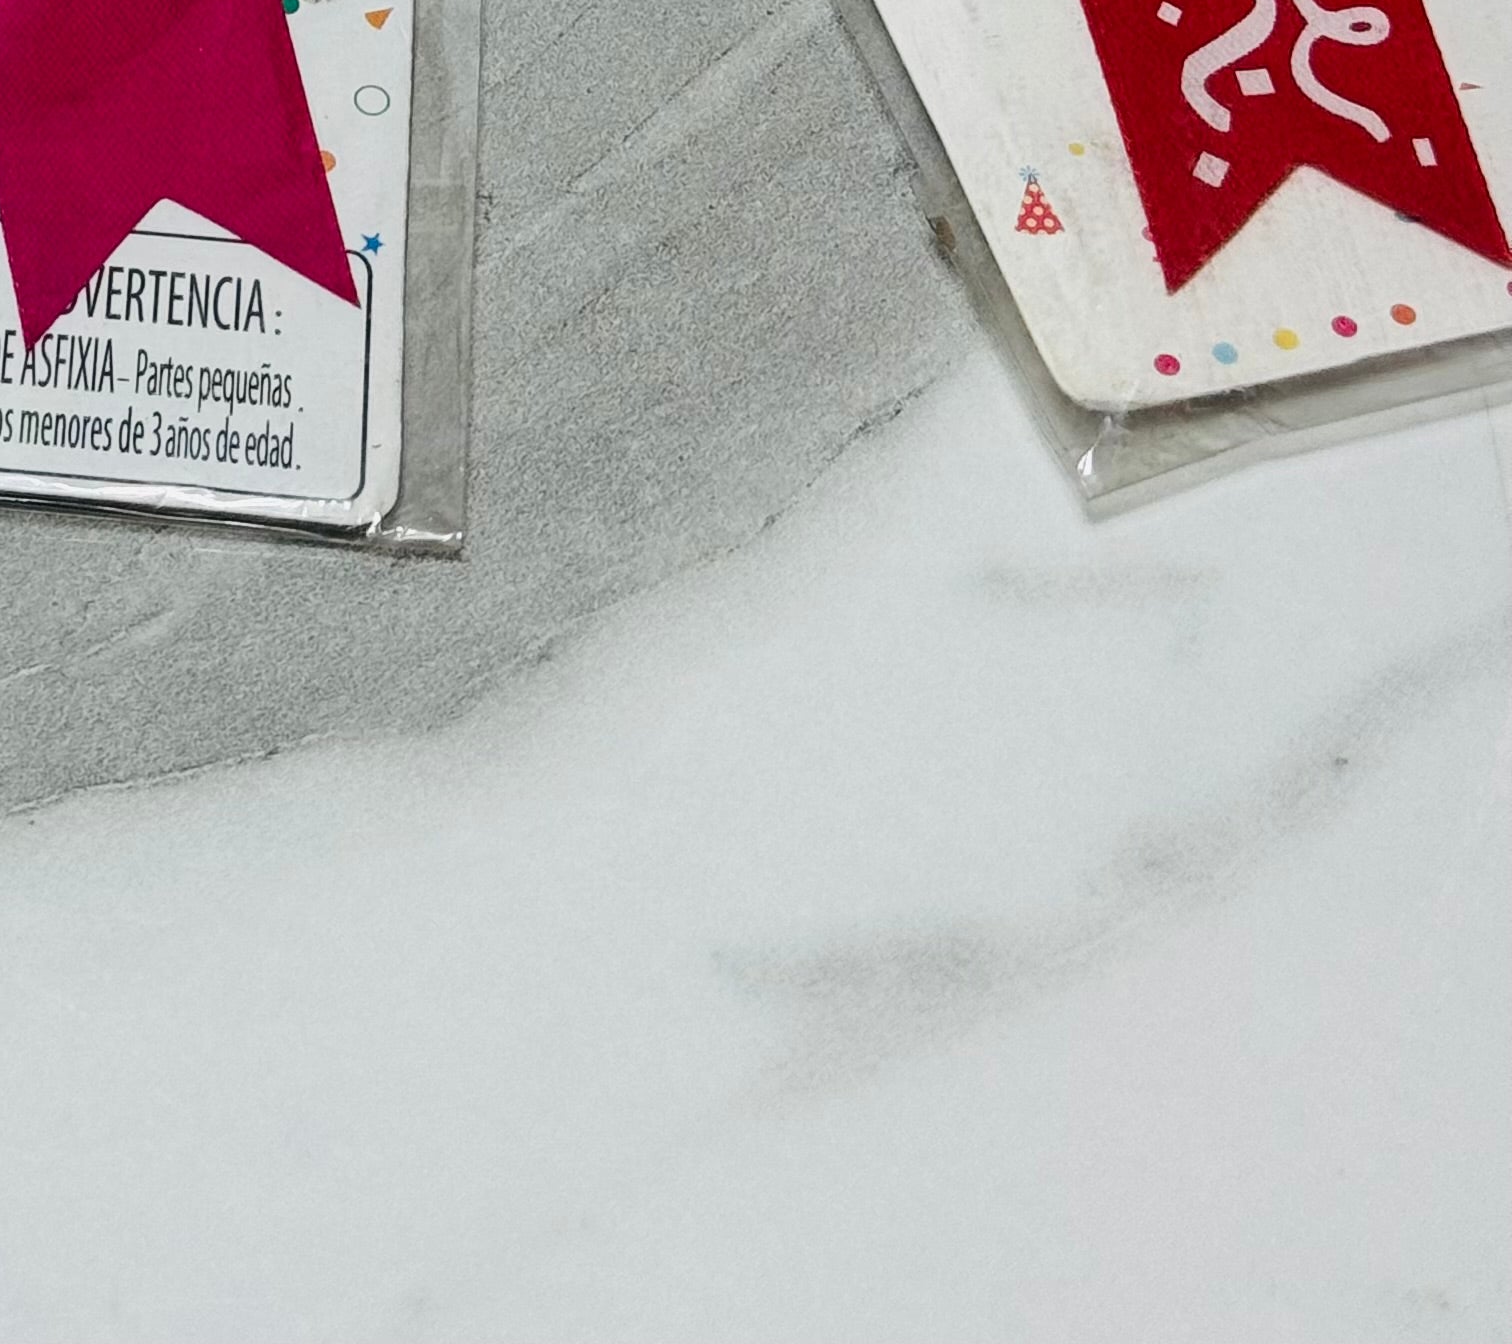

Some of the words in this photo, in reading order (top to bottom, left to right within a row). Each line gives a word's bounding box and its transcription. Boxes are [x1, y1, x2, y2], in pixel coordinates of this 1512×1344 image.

[60, 263, 283, 336] VERTENCIA:
[20, 333, 115, 394] ASFIXIA
[134, 348, 193, 400] Partes
[18, 405, 113, 454] menores
[118, 406, 145, 456] de
[149, 412, 163, 458] 3
[164, 416, 213, 462] años
[215, 416, 241, 465] de
[244, 422, 303, 471] edad.
